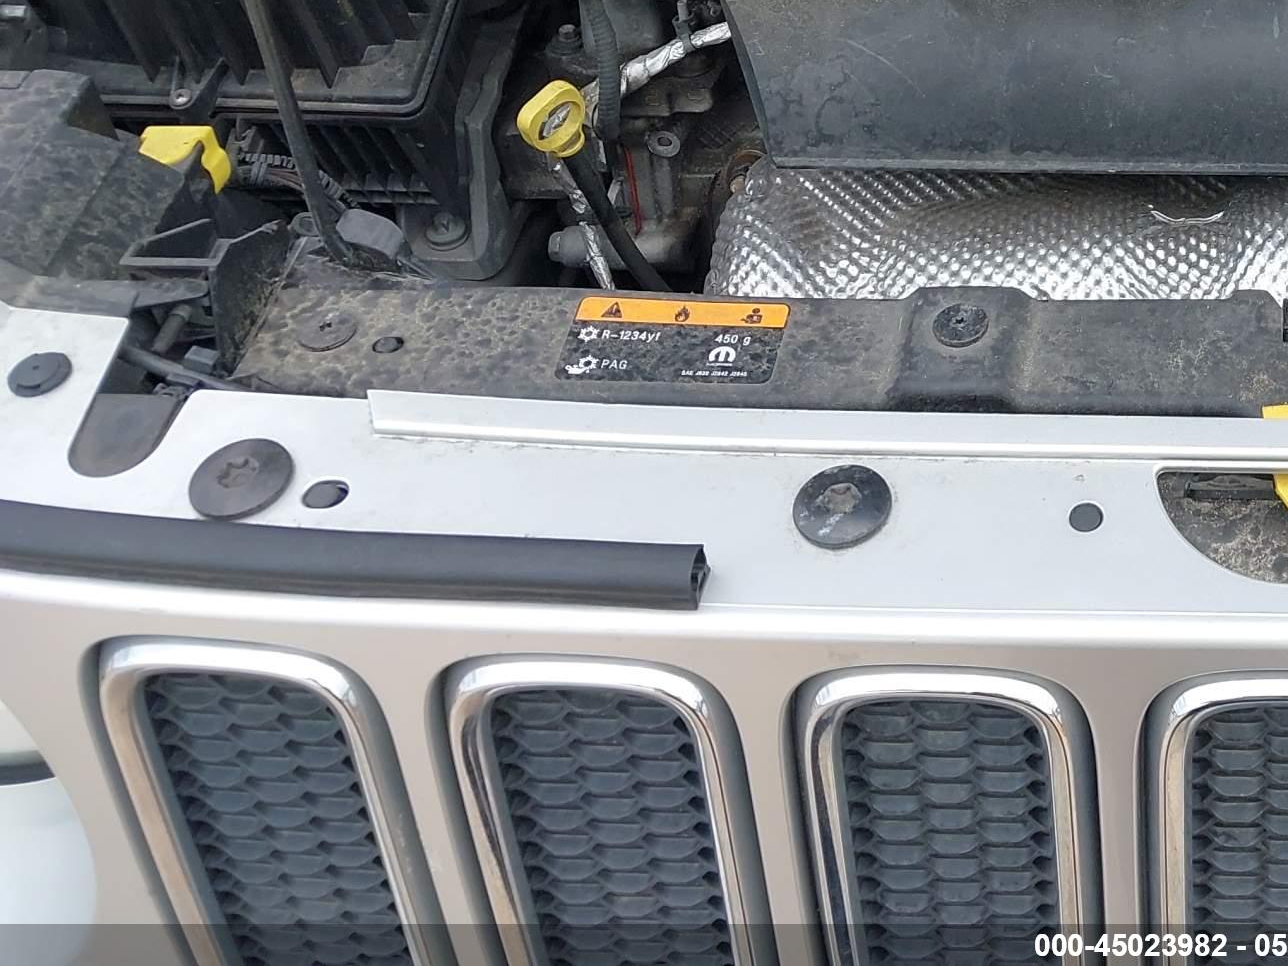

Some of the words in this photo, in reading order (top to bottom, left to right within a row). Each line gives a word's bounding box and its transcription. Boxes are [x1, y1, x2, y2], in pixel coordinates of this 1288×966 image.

[601, 329, 661, 343] R-1234yf
[715, 333, 738, 344] 450
[742, 336, 751, 346] g
[601, 359, 628, 370] PAG
